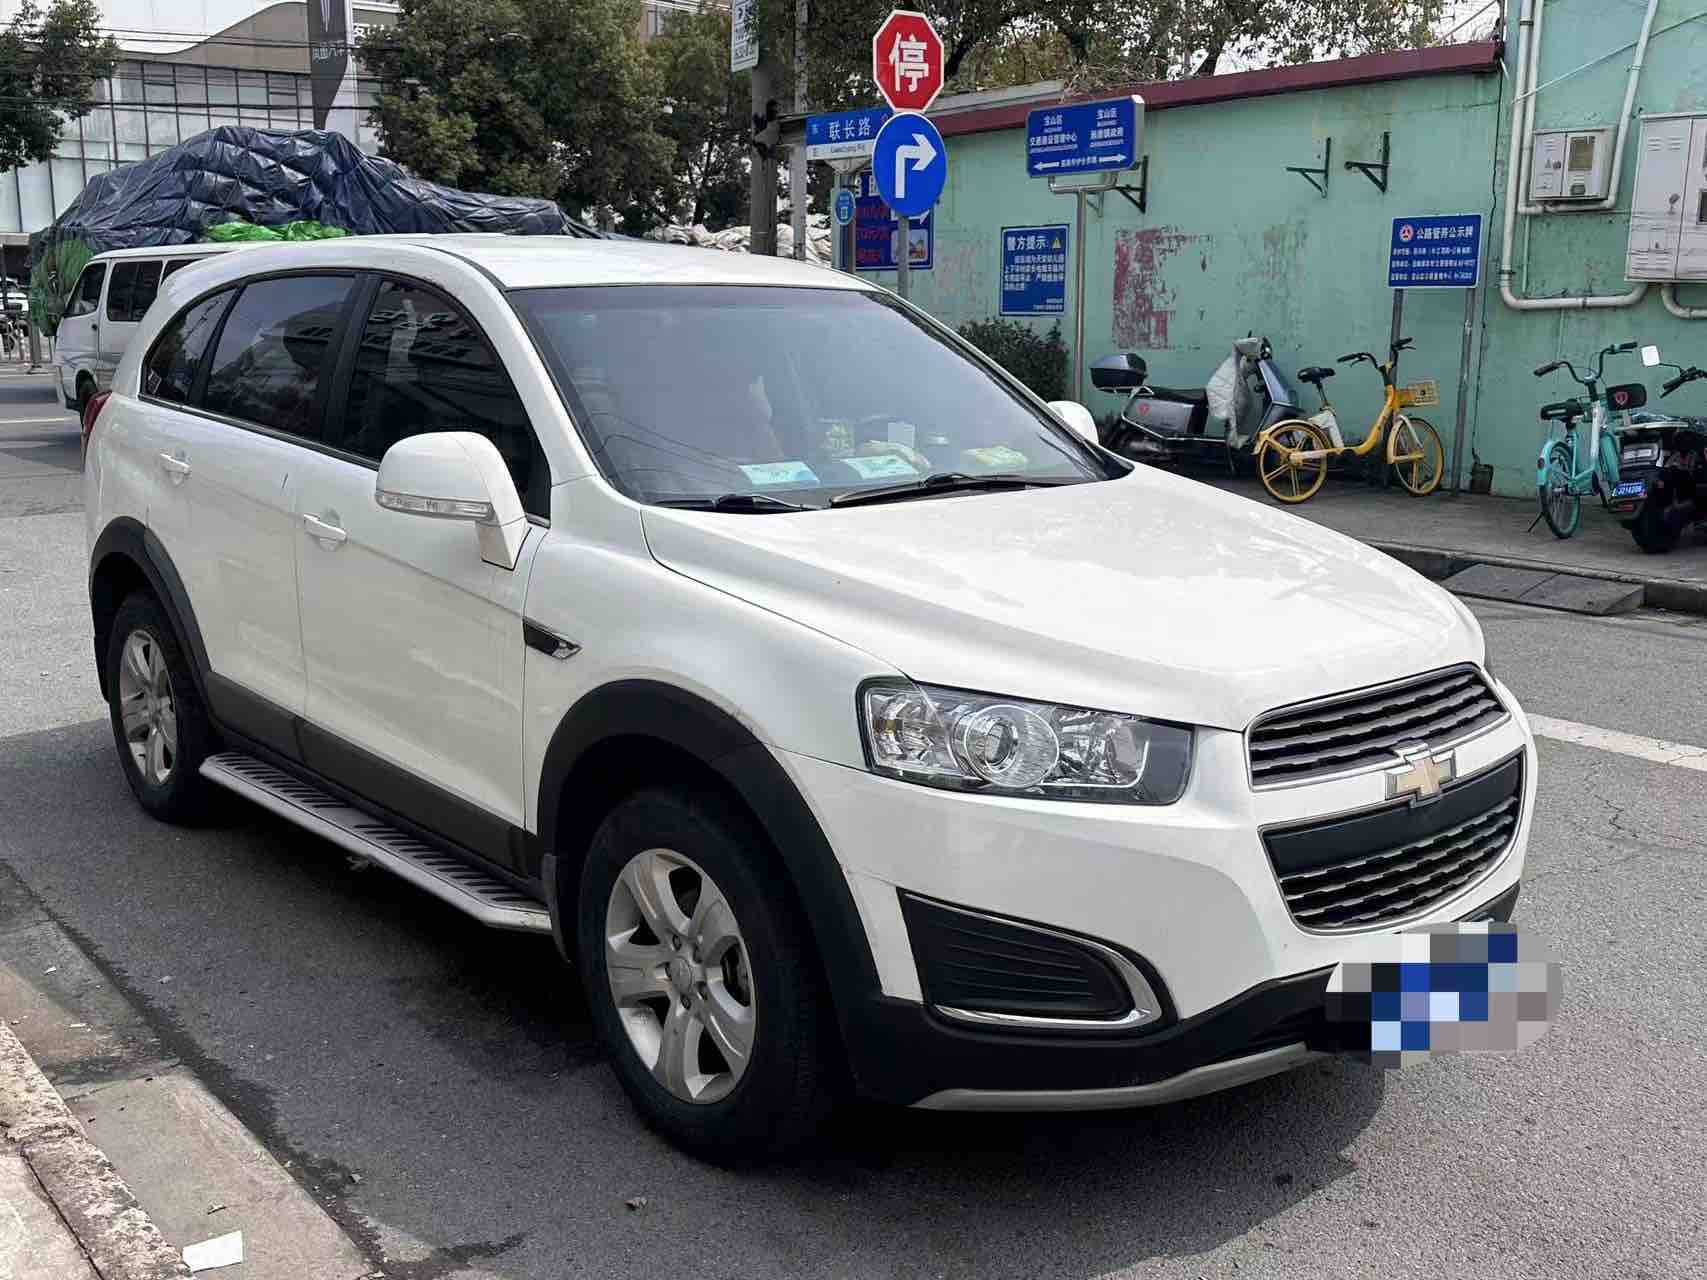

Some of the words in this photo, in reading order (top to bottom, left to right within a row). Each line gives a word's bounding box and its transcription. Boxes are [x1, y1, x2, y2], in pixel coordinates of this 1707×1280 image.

[888, 31, 929, 93] 停
[828, 116, 872, 140] 联长路
